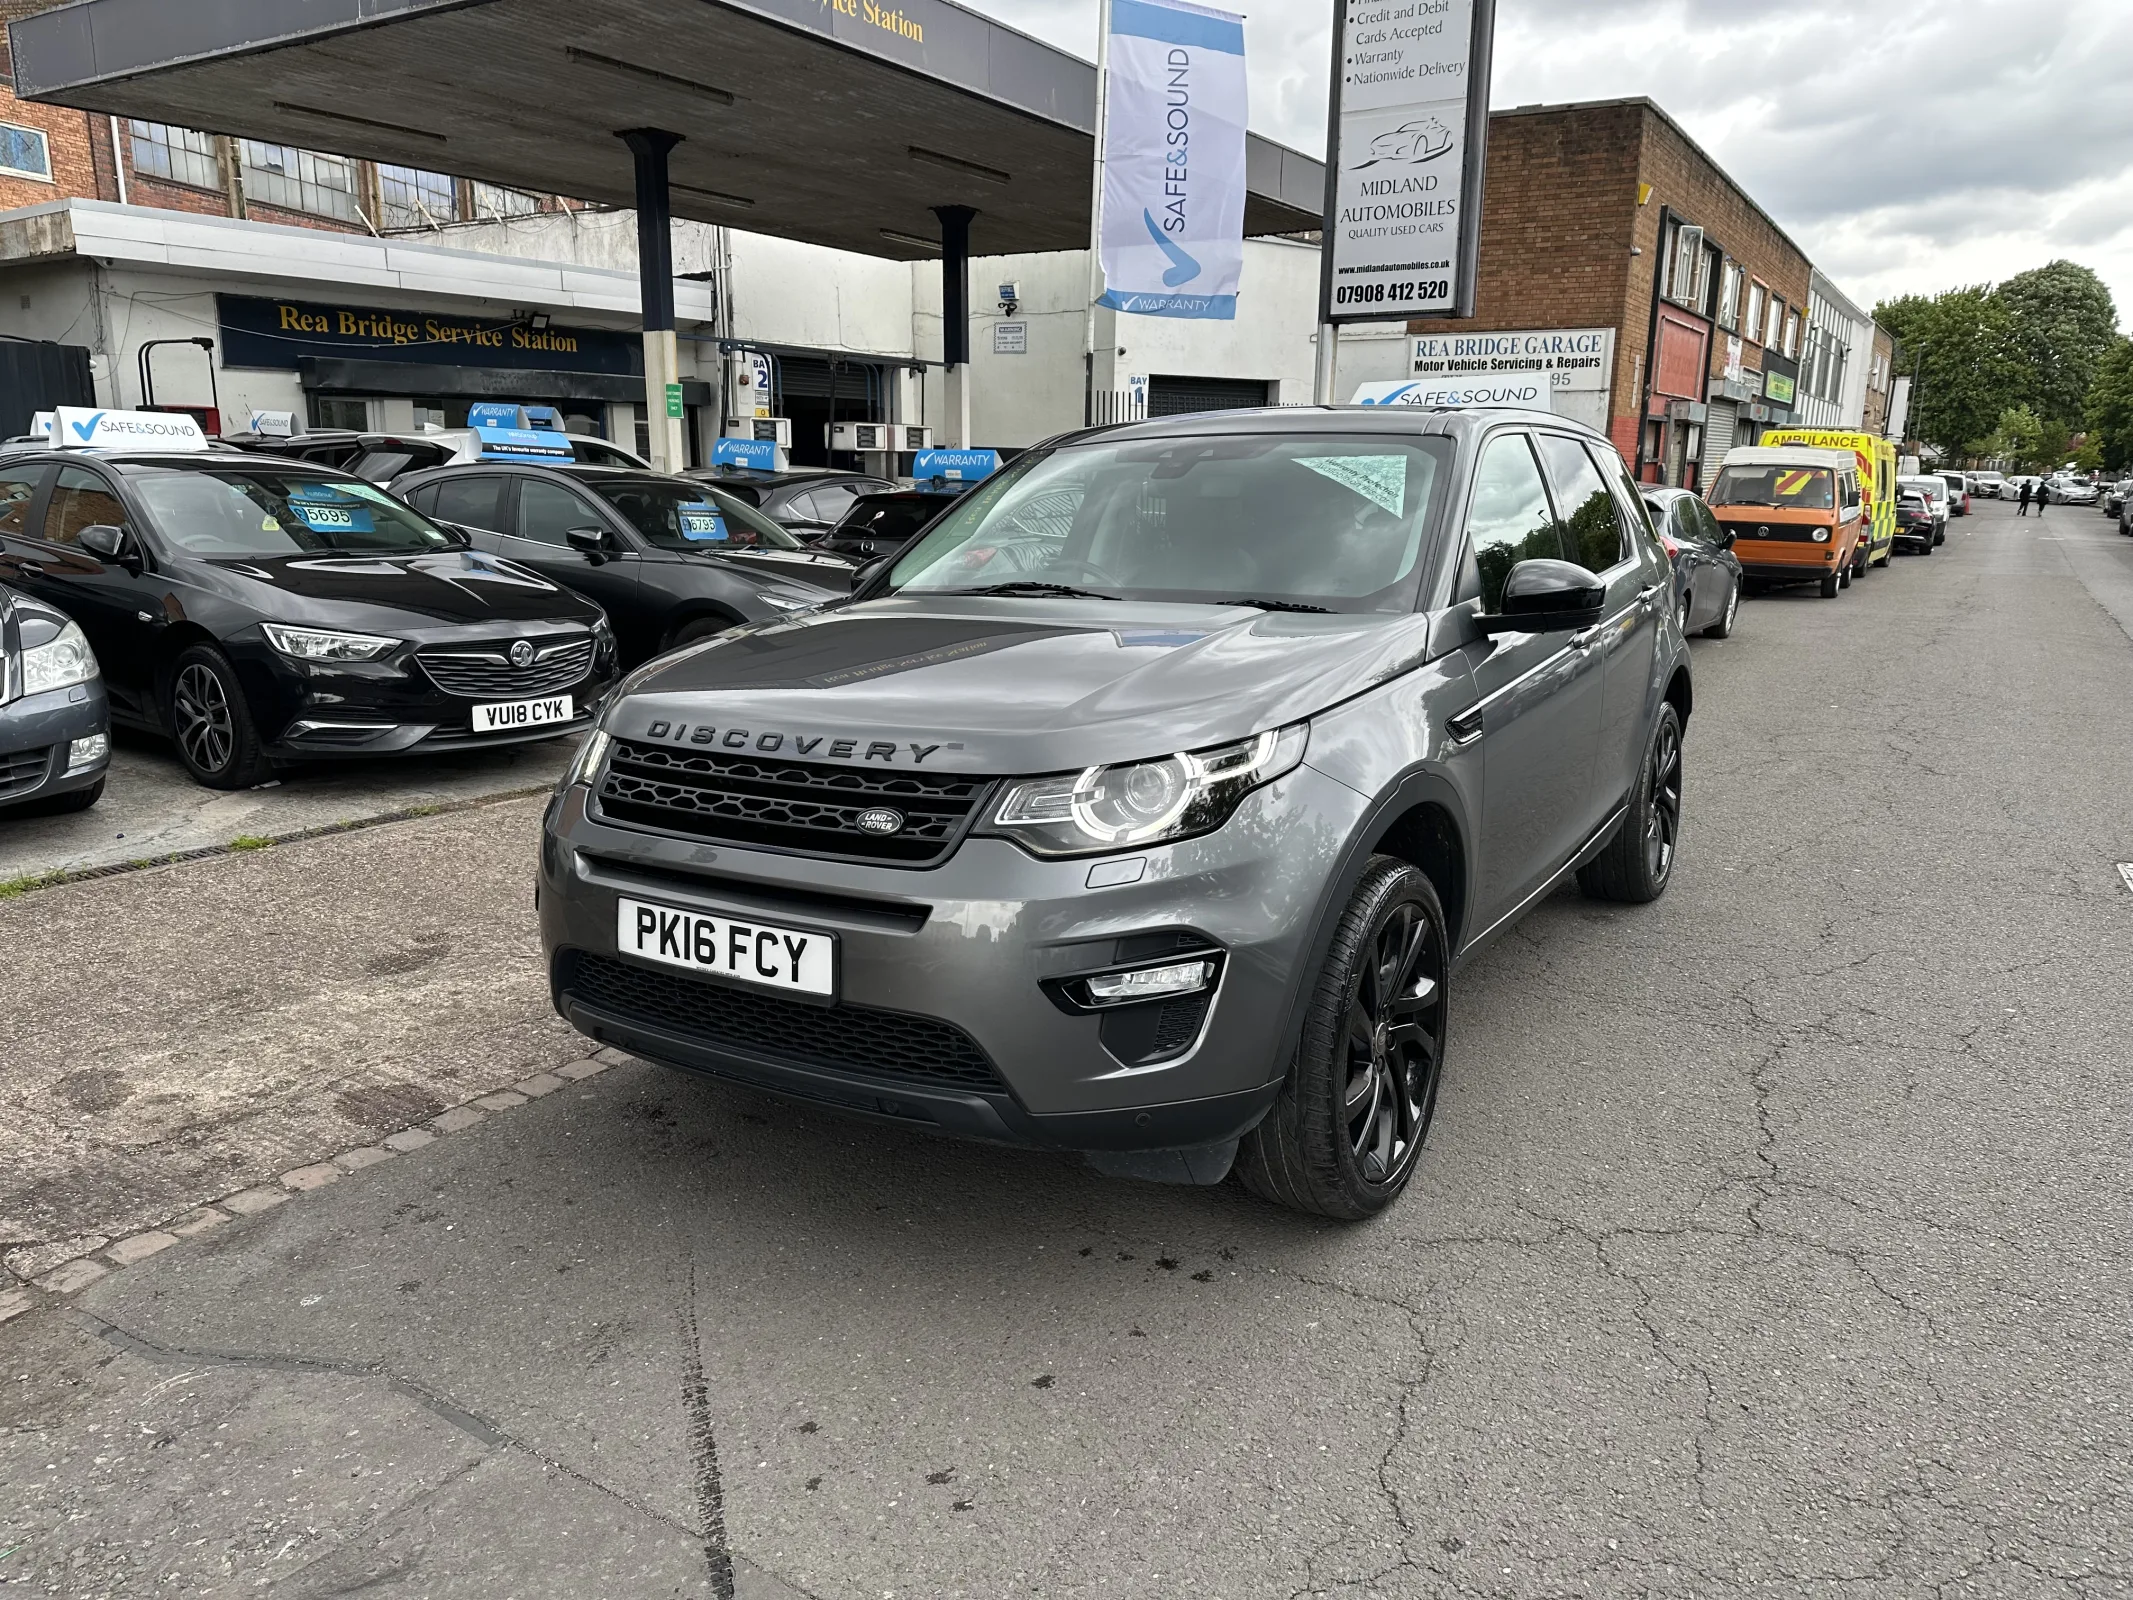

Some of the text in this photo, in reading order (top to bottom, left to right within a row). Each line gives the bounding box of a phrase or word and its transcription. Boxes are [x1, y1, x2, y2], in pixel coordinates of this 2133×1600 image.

[863, 0, 924, 43] Station
[1357, 0, 1450, 25] Credit and Debit
[1356, 20, 1443, 45] Cards Accepted
[1355, 48, 1404, 65] Warranty
[1354, 61, 1466, 85] Nationwide Delivery
[1163, 48, 1190, 233] SAFE&SOUND
[1360, 175, 1438, 197] MIDLAND
[1339, 199, 1456, 223] AUTOMOBILES
[1348, 222, 1444, 239] QUALITY USED CARS
[1338, 259, 1450, 275] www.midlandautomobiles.co.uk
[1336, 280, 1448, 304] 07908 412 520
[1138, 297, 1210, 312] WARRANTY
[278, 305, 578, 353] Rea Bridge Service Station
[1415, 334, 1602, 357] REA BRIDGE GARAGE
[1414, 356, 1601, 372] Motor Vehicle Servicing & Repairs
[757, 370, 768, 388] 2
[1130, 376, 1148, 385] BAY
[1401, 386, 1538, 405] SAFE&SOUND
[481, 406, 515, 418] WARRANTY
[100, 420, 195, 437] SAFE&SOUND
[728, 443, 772, 457] WARRANTY
[1770, 434, 1860, 448] AMBULANCE
[933, 454, 990, 466] WARRANTY
[1360, 474, 1400, 499] Protection
[486, 699, 563, 726] VU18 CYK
[646, 719, 941, 764] DISCOVERY
[636, 905, 808, 983] PK16 FCY
